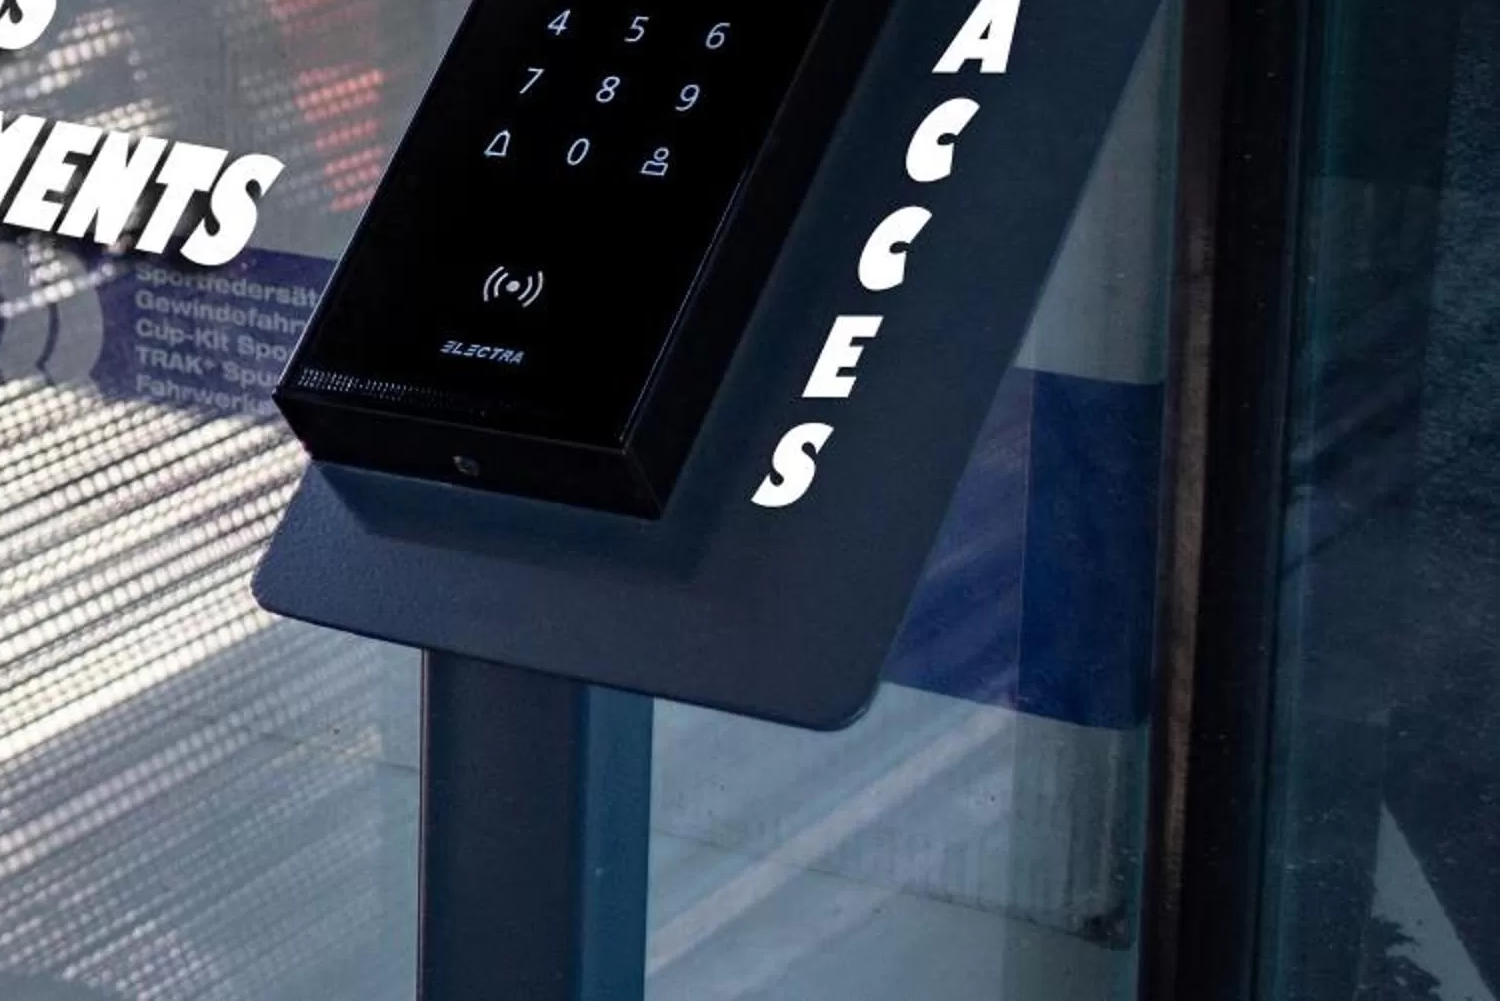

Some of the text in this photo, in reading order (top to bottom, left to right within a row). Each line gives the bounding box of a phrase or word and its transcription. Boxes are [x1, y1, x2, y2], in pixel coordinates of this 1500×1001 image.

[547, 9, 731, 49] 4 5 6
[519, 67, 700, 112] 7 8 9
[566, 137, 591, 166] 0
[135, 262, 321, 309] Sportfedersät
[134, 289, 307, 335] Gewindefahr
[135, 317, 291, 362] Cup-Kit Spo
[439, 340, 526, 366] ELECTRA
[222, 360, 280, 389] Spu
